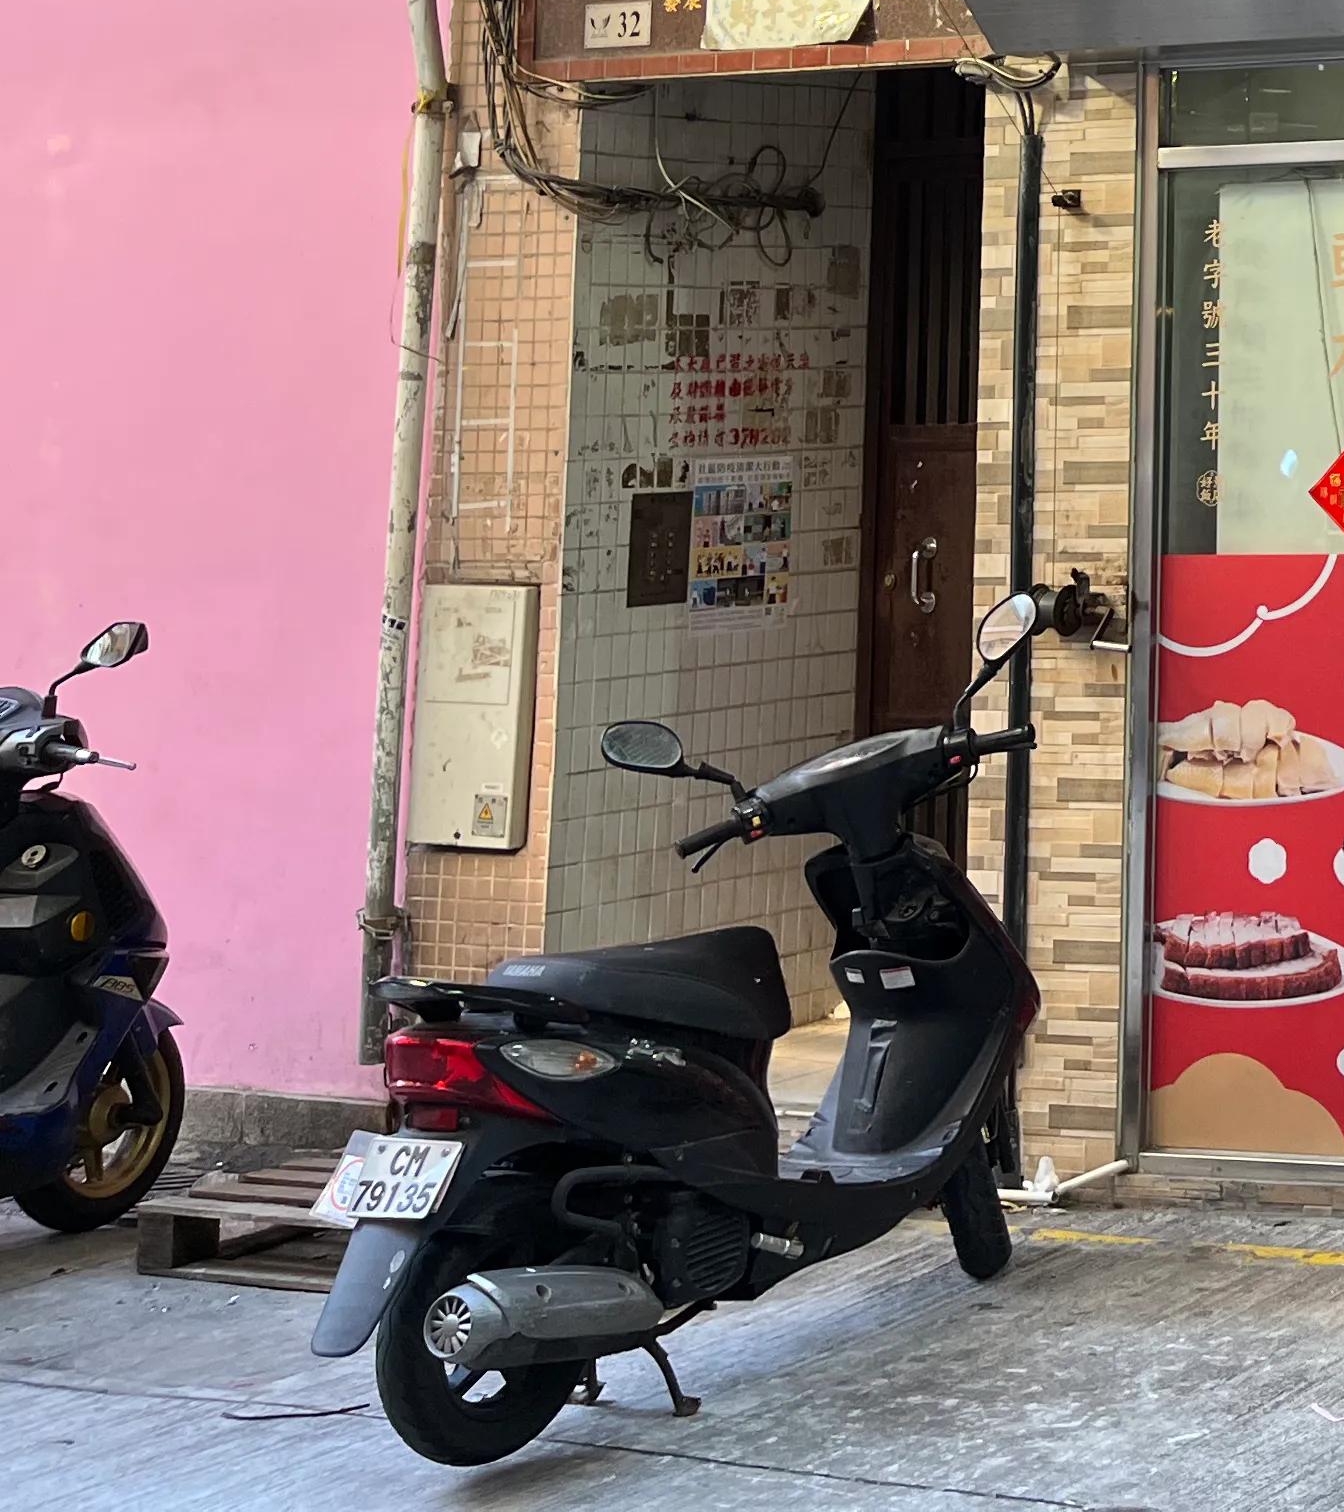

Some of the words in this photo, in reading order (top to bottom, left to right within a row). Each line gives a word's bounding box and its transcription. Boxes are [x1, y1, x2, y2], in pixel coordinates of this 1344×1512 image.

[617, 11, 642, 39] 32
[502, 964, 546, 977] YAMAHA
[388, 1145, 432, 1178] CM
[351, 1180, 437, 1214] 79135
